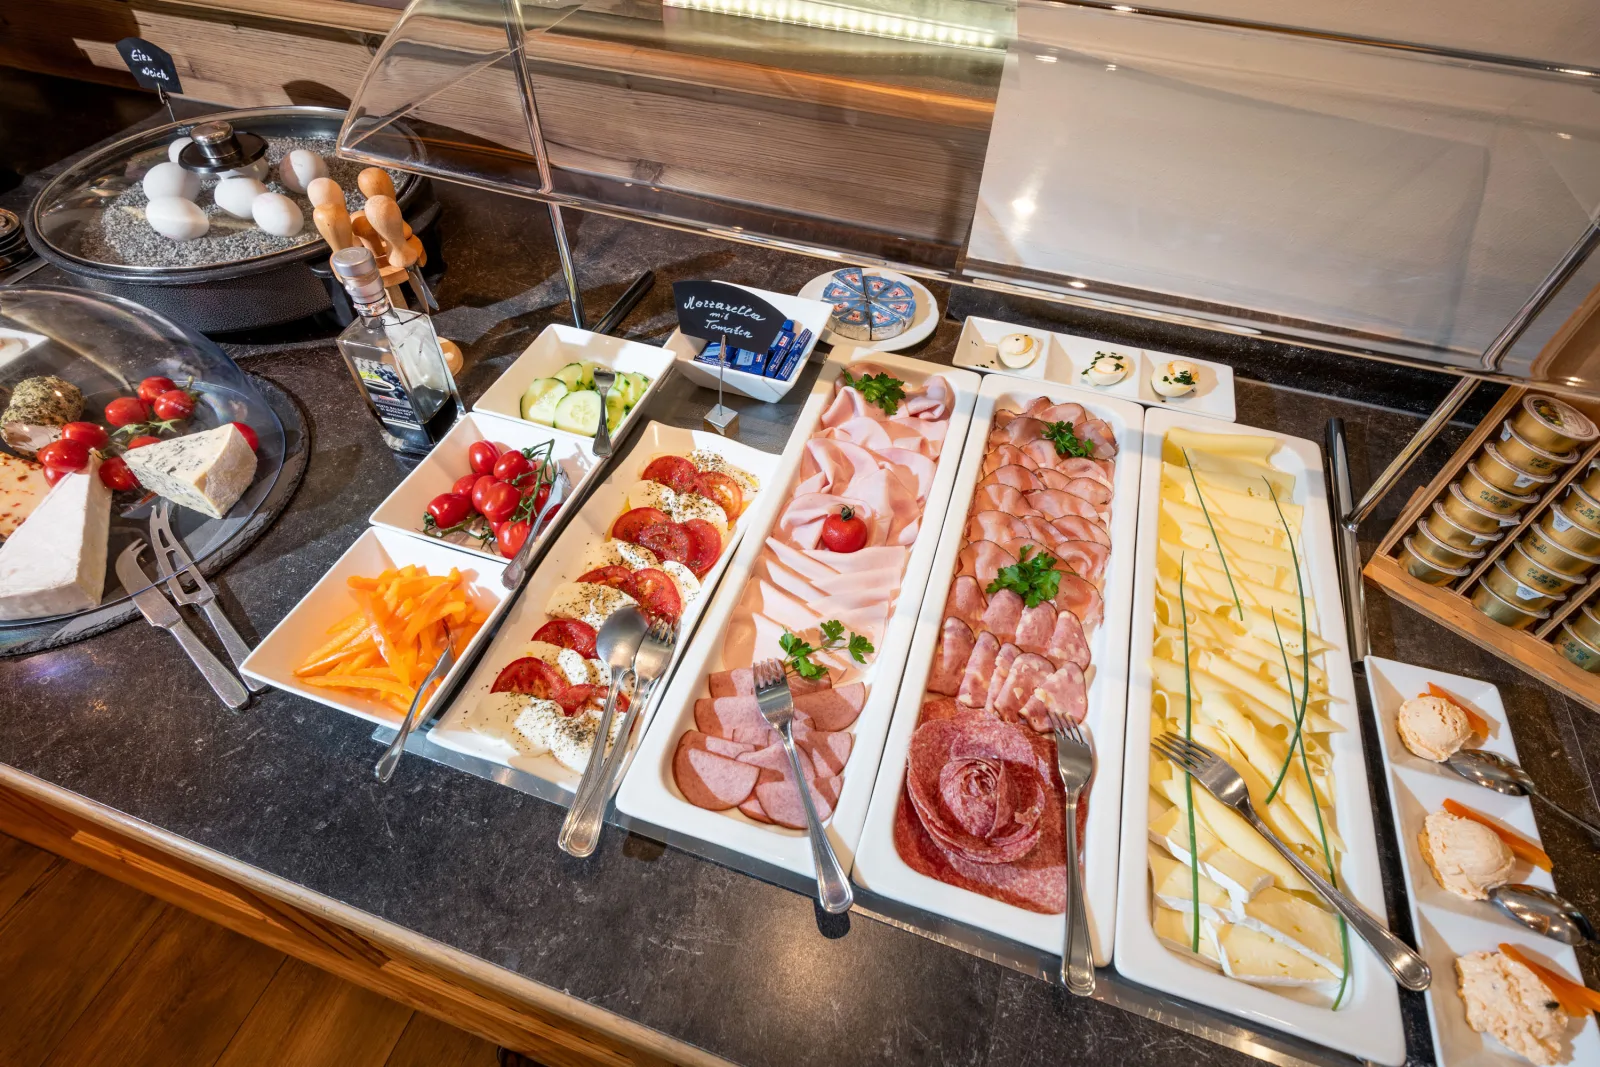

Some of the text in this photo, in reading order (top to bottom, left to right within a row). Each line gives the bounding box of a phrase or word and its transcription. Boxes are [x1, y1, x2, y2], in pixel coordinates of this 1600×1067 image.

[131, 49, 153, 61] Eier
[683, 296, 766, 321] Mozzarella
[709, 312, 729, 320] mit
[704, 319, 753, 338] Tomaten
